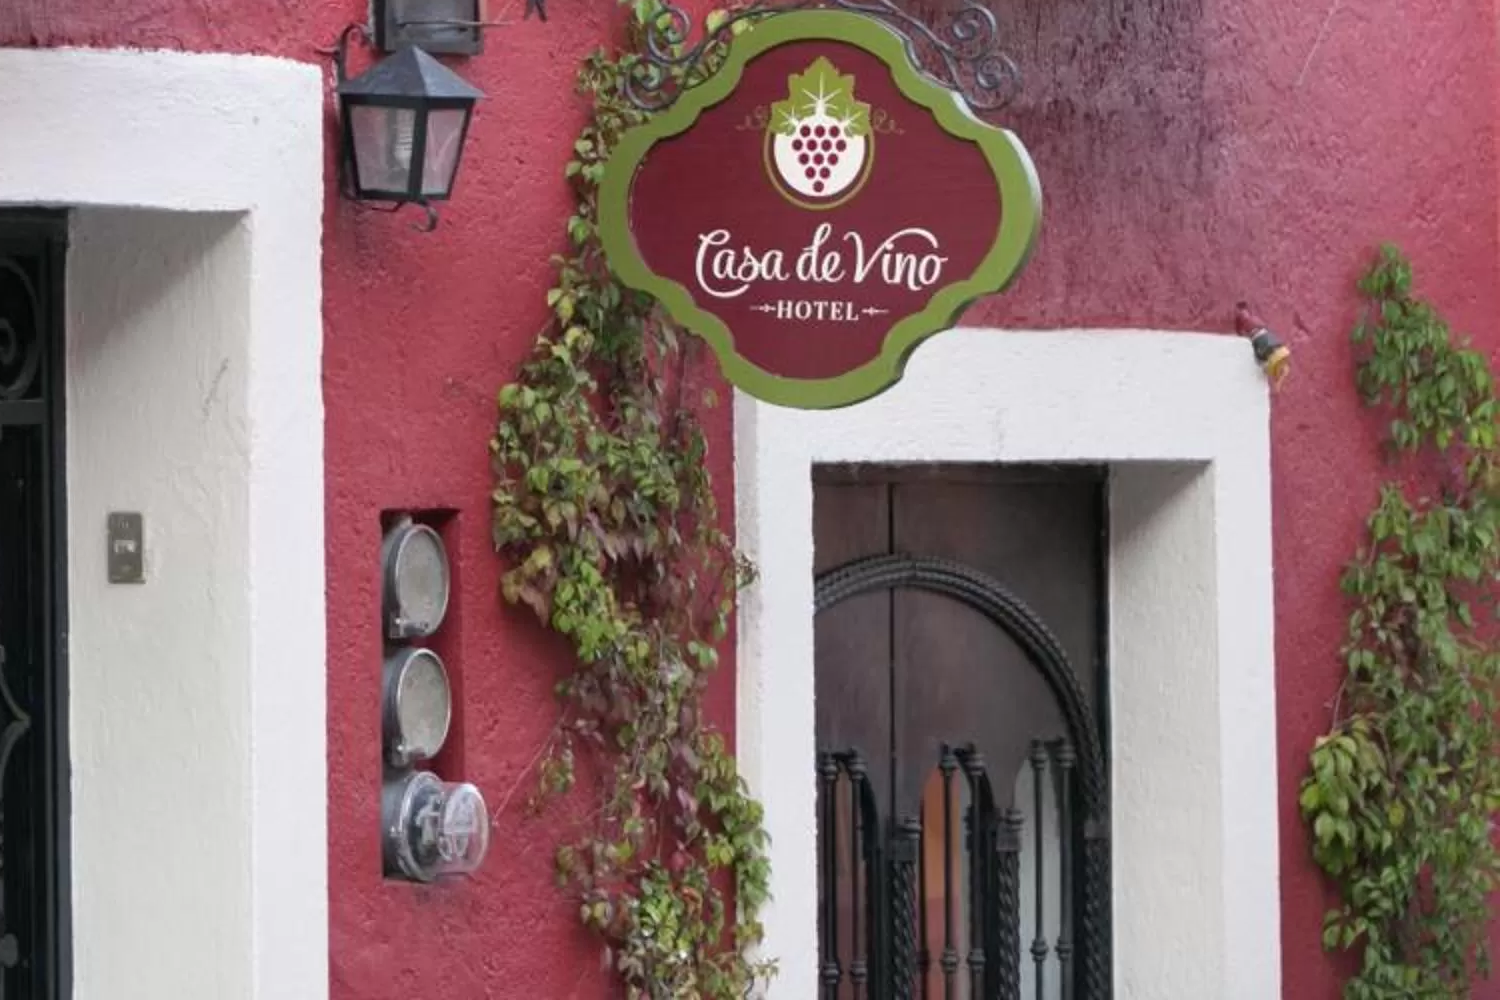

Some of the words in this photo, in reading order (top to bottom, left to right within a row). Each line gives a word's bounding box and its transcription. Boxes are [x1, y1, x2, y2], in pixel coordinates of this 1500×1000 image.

[696, 229, 790, 298] Casa
[796, 222, 845, 283] de
[843, 228, 948, 291] Vino
[777, 300, 859, 321] HOTEL
